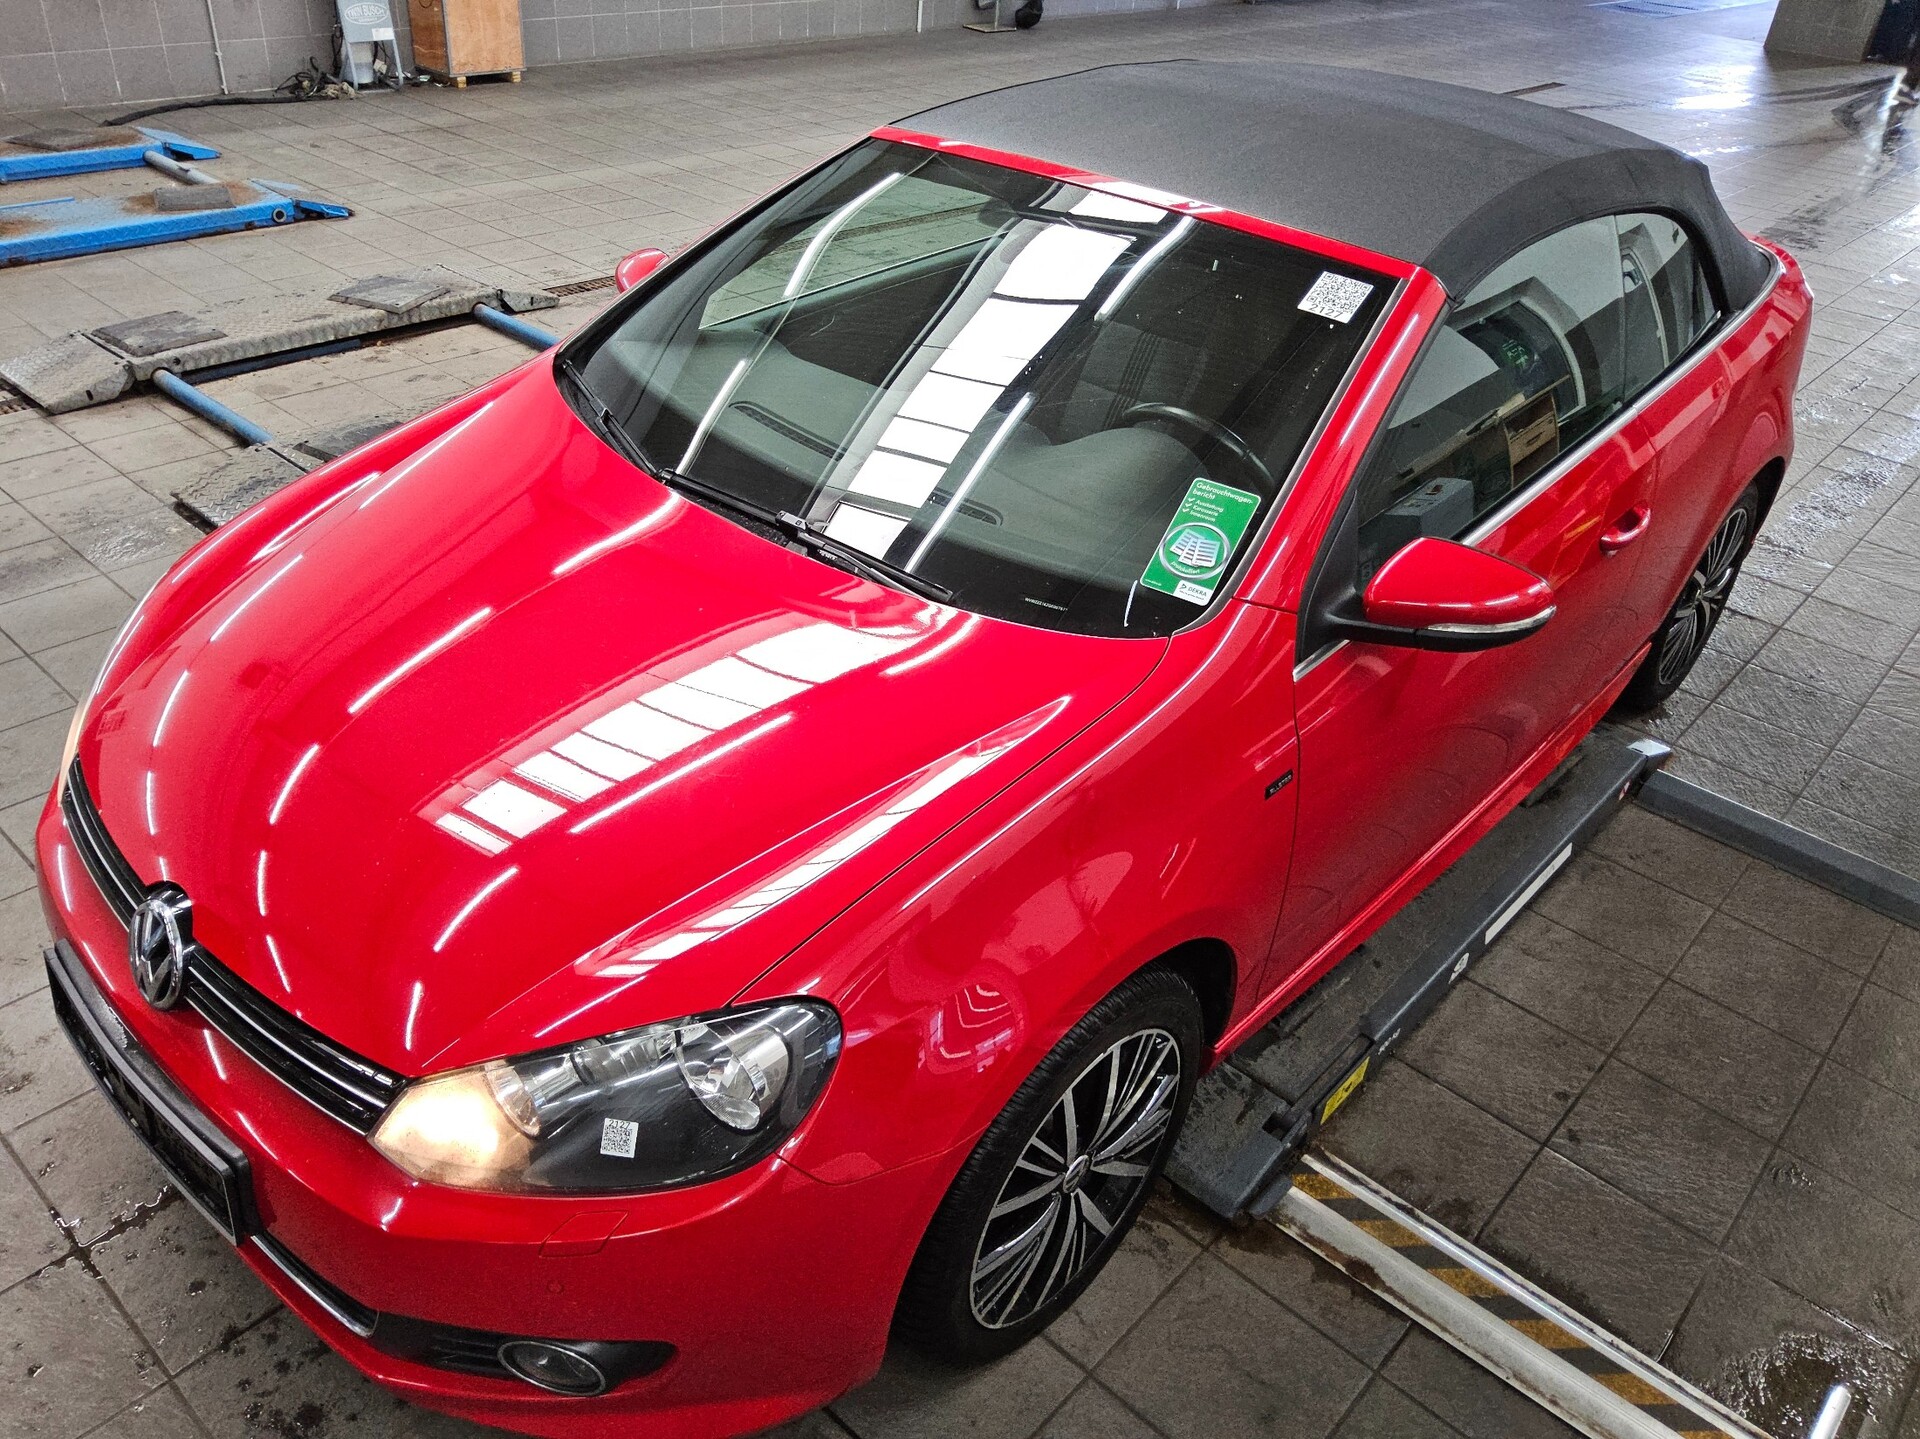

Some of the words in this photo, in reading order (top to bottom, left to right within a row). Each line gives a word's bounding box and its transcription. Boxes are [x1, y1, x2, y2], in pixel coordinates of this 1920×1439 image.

[362, 4, 386, 17] BUSCH
[1308, 303, 1344, 319] 2127
[1192, 487, 1216, 500] bericht
[1192, 505, 1219, 517] Karosserie
[1195, 499, 1224, 513] Ausstattung
[1187, 586, 1207, 597] DEKRA
[609, 1119, 631, 1130] 2127
